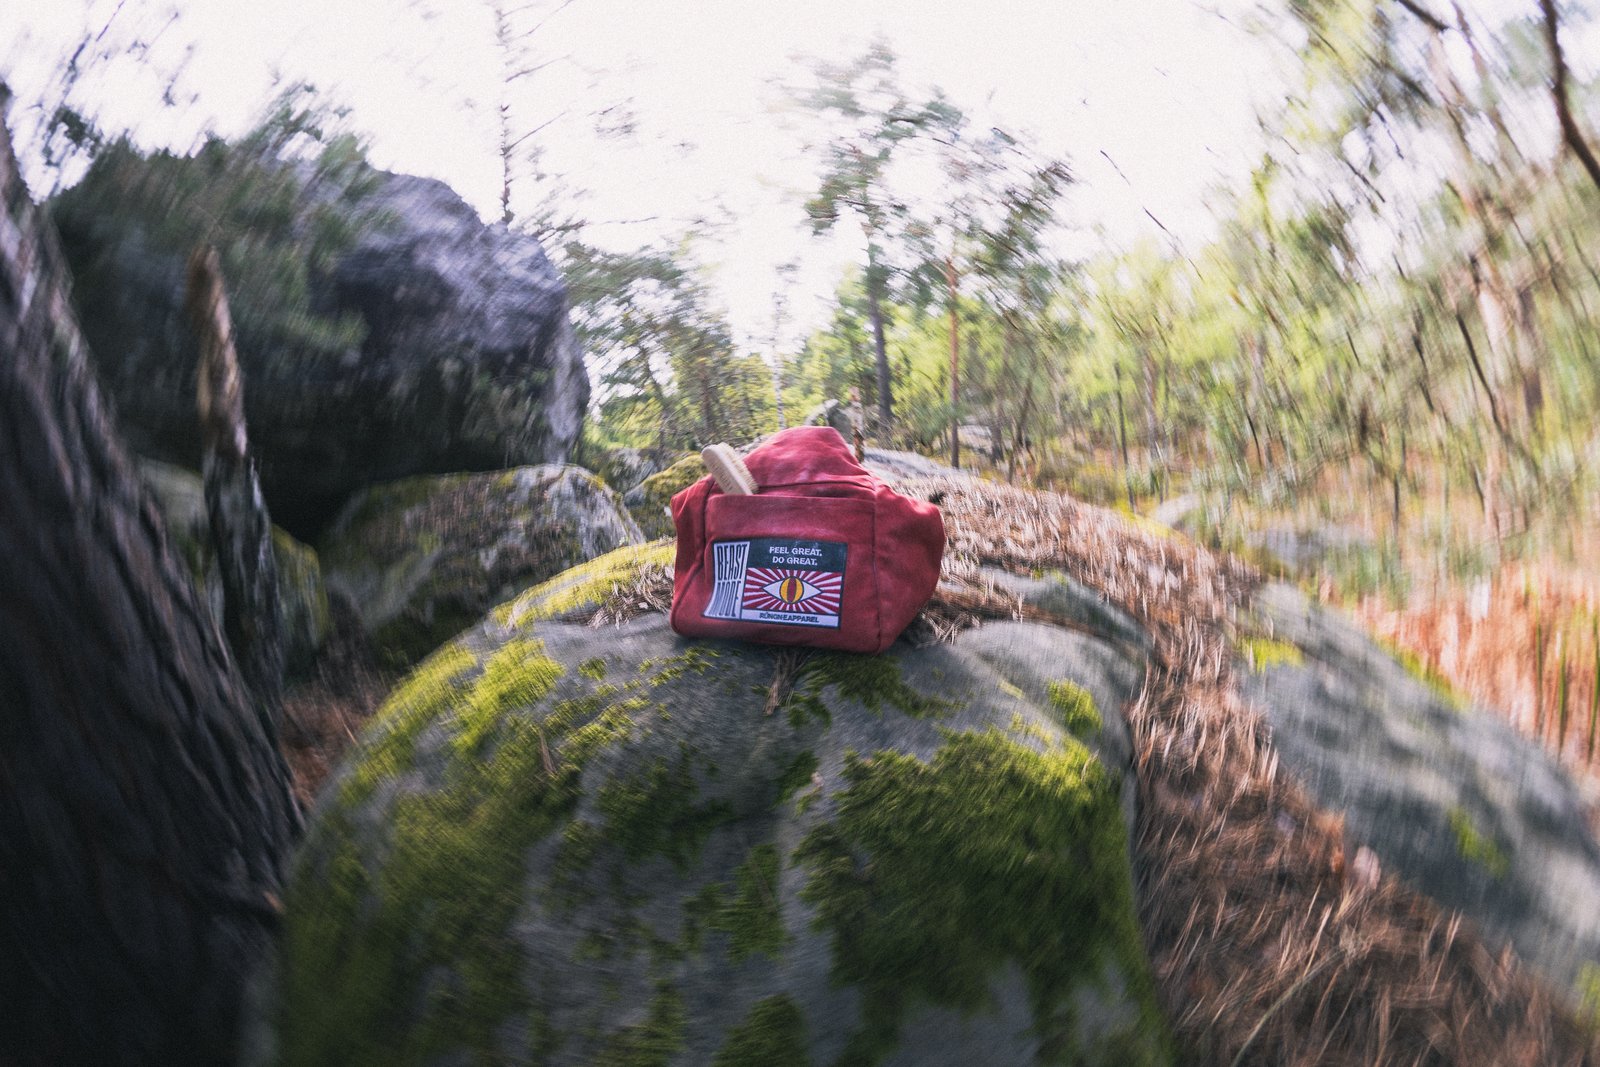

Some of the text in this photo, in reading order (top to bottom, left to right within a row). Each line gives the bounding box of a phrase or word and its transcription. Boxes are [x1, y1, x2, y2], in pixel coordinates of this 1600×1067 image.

[717, 544, 747, 580] BEAST
[769, 546, 822, 556] FEEL GREAT.
[772, 556, 818, 566] DO GREAT.
[708, 581, 741, 617] MODE
